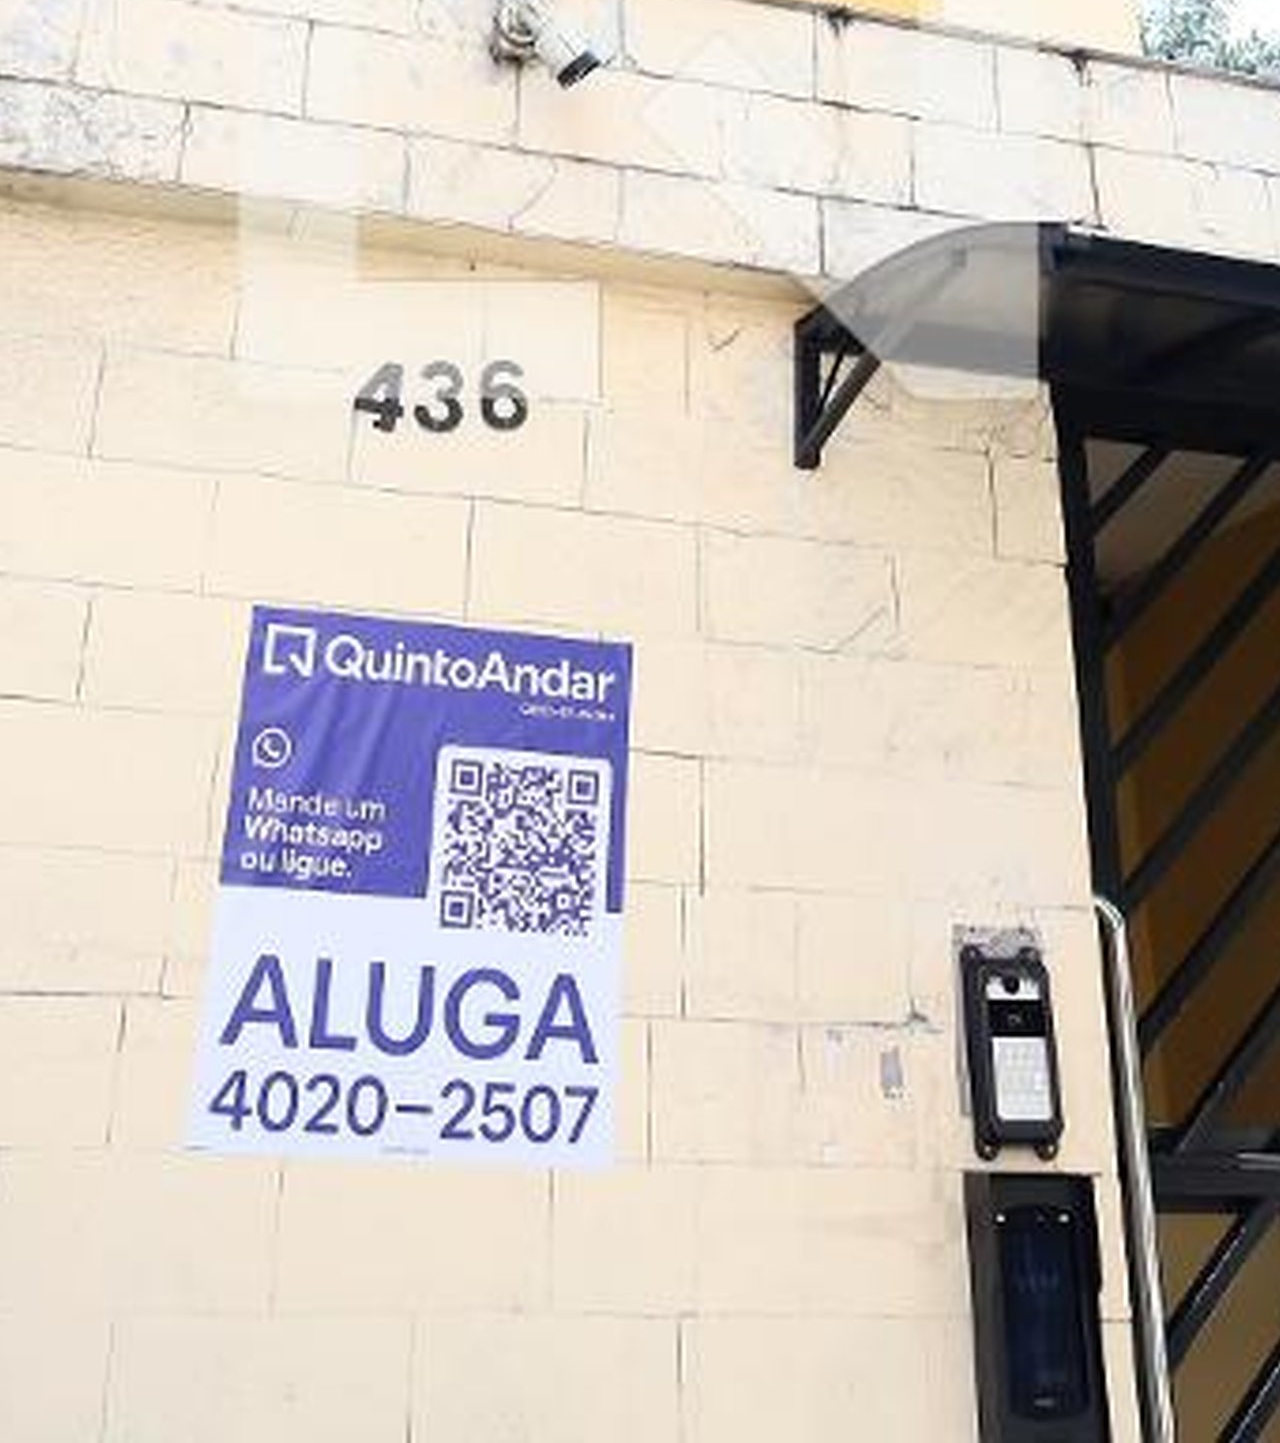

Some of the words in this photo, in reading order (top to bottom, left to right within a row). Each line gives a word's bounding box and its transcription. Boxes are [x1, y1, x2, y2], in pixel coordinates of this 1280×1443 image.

[353, 360, 529, 434] 436
[324, 634, 616, 703] QuintoAndar
[243, 815, 382, 855] Whatsapp
[248, 788, 338, 818] Mande
[219, 954, 600, 1064] ALUGA
[208, 1069, 600, 1145] 4020-2507
